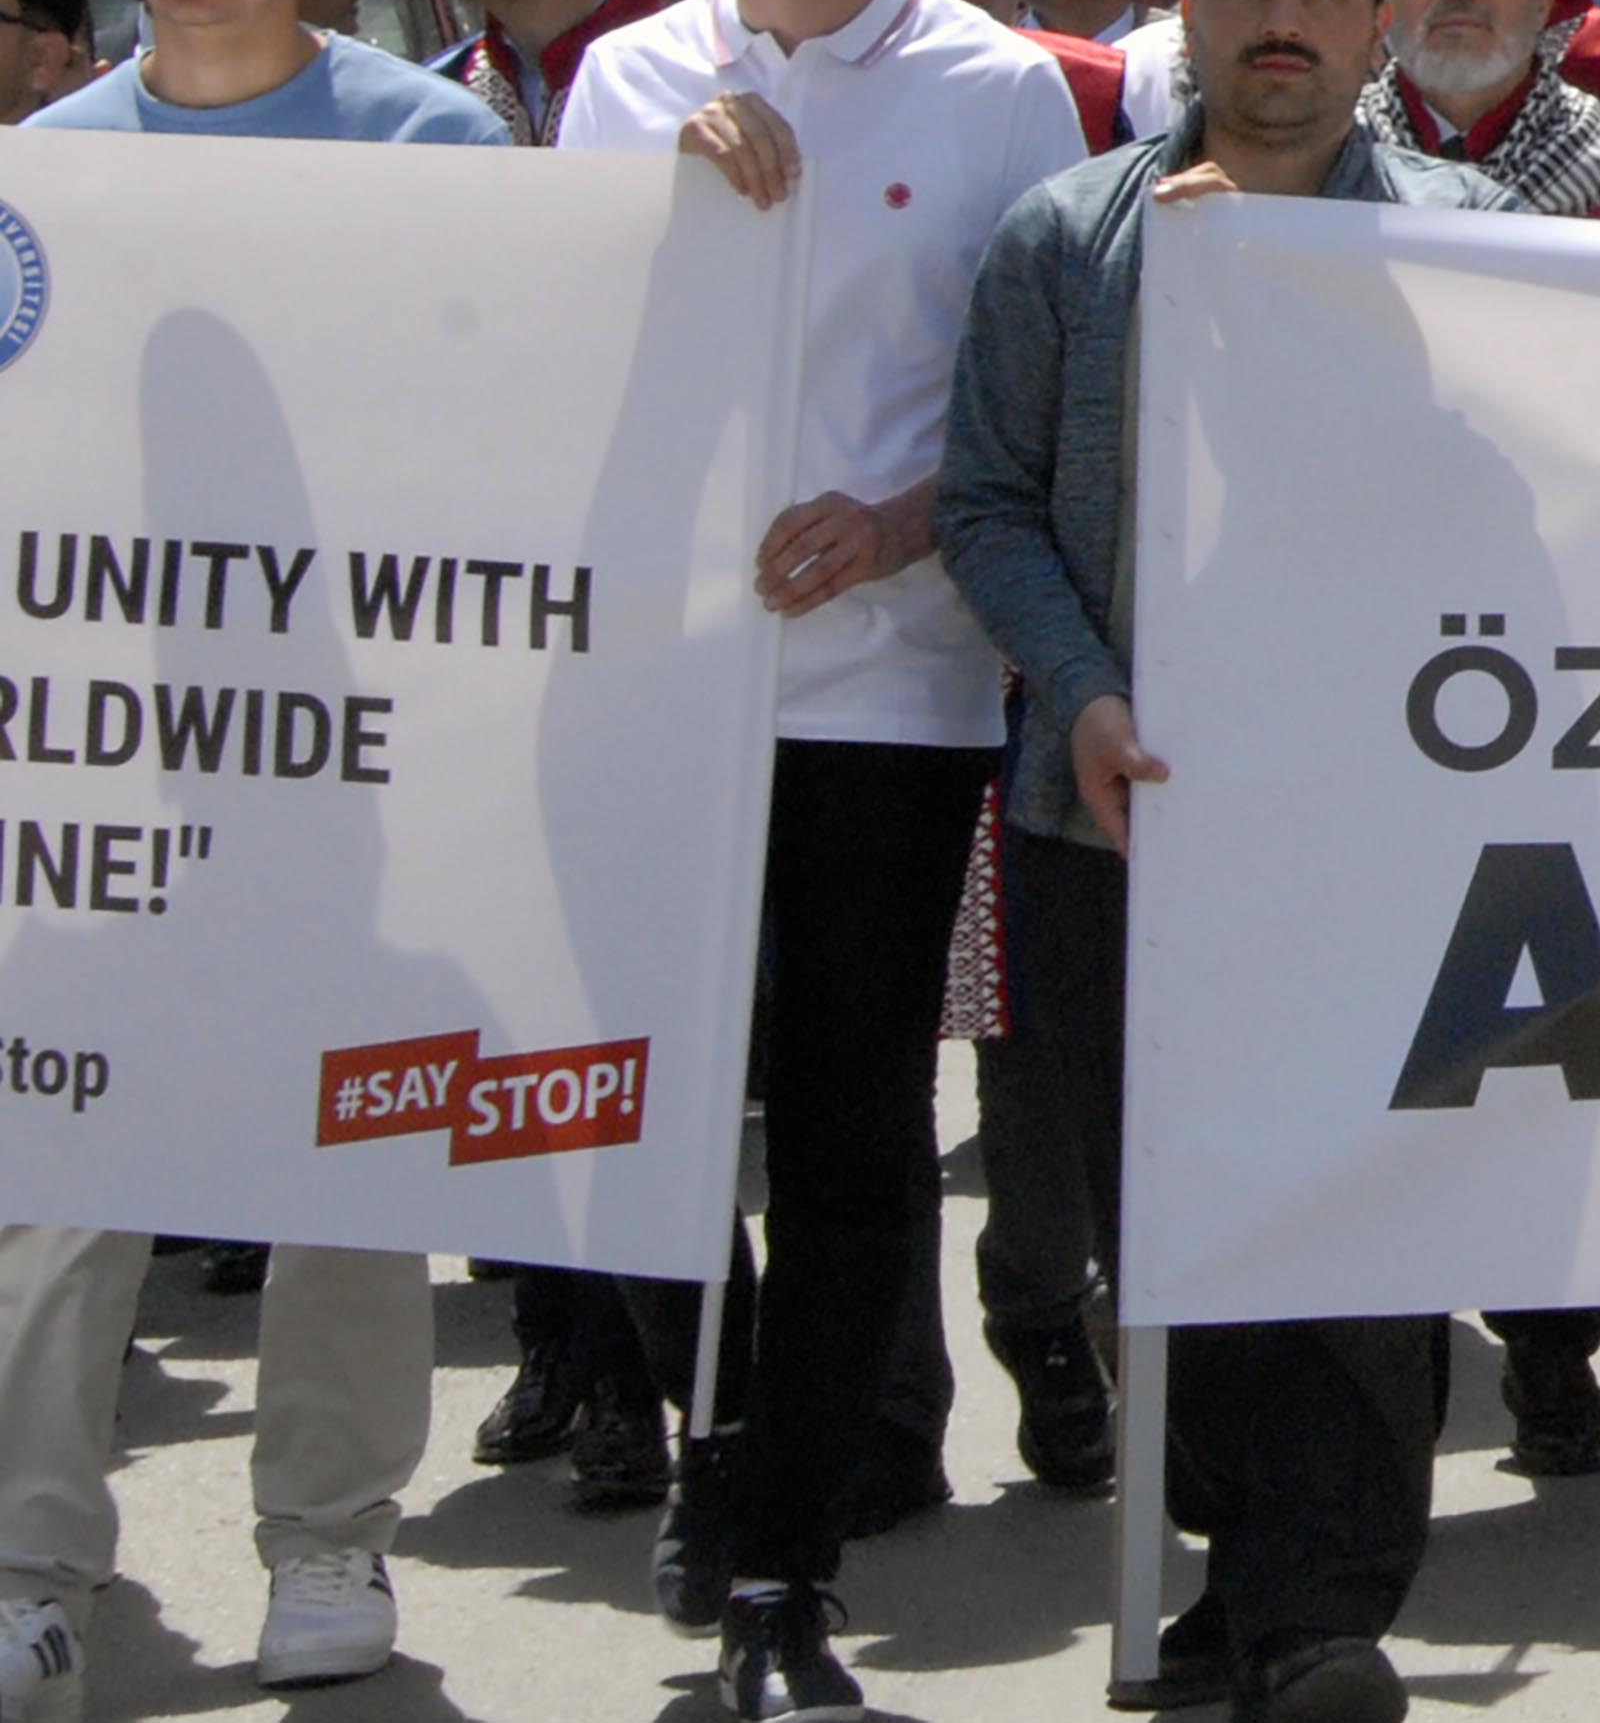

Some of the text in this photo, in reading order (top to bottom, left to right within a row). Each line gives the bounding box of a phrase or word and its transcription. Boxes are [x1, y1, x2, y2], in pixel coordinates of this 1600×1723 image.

[17, 531, 592, 654] UNITY WITH
[0, 1037, 110, 1113] top
[335, 1058, 637, 1137] #SAY STOP!
